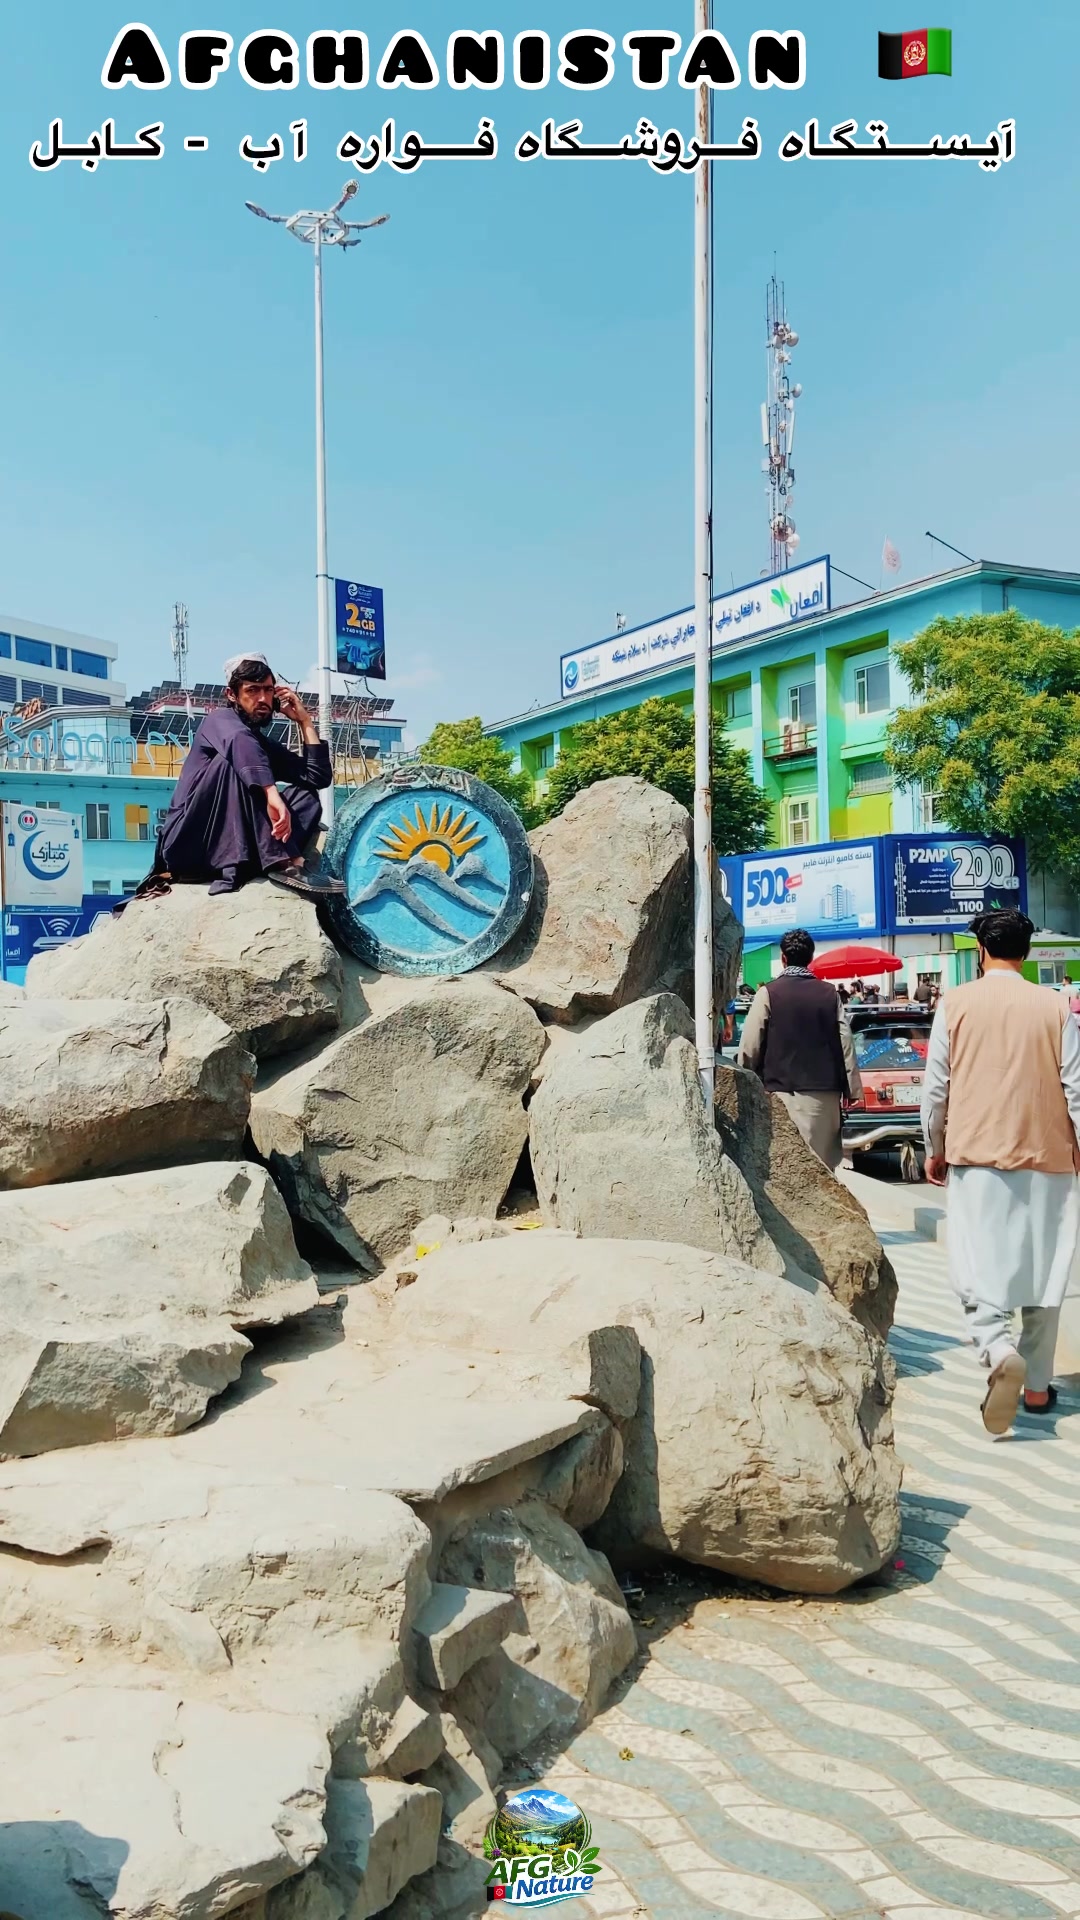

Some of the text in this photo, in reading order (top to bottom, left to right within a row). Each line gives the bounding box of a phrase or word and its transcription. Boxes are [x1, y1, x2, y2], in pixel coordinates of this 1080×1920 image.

[361, 619, 376, 631] GB
[2, 716, 138, 764] Salaam
[909, 848, 949, 864] P2MP
[949, 844, 1016, 890] 200
[746, 867, 790, 908] 500
[785, 893, 797, 904] GB
[958, 900, 984, 913] 1100
